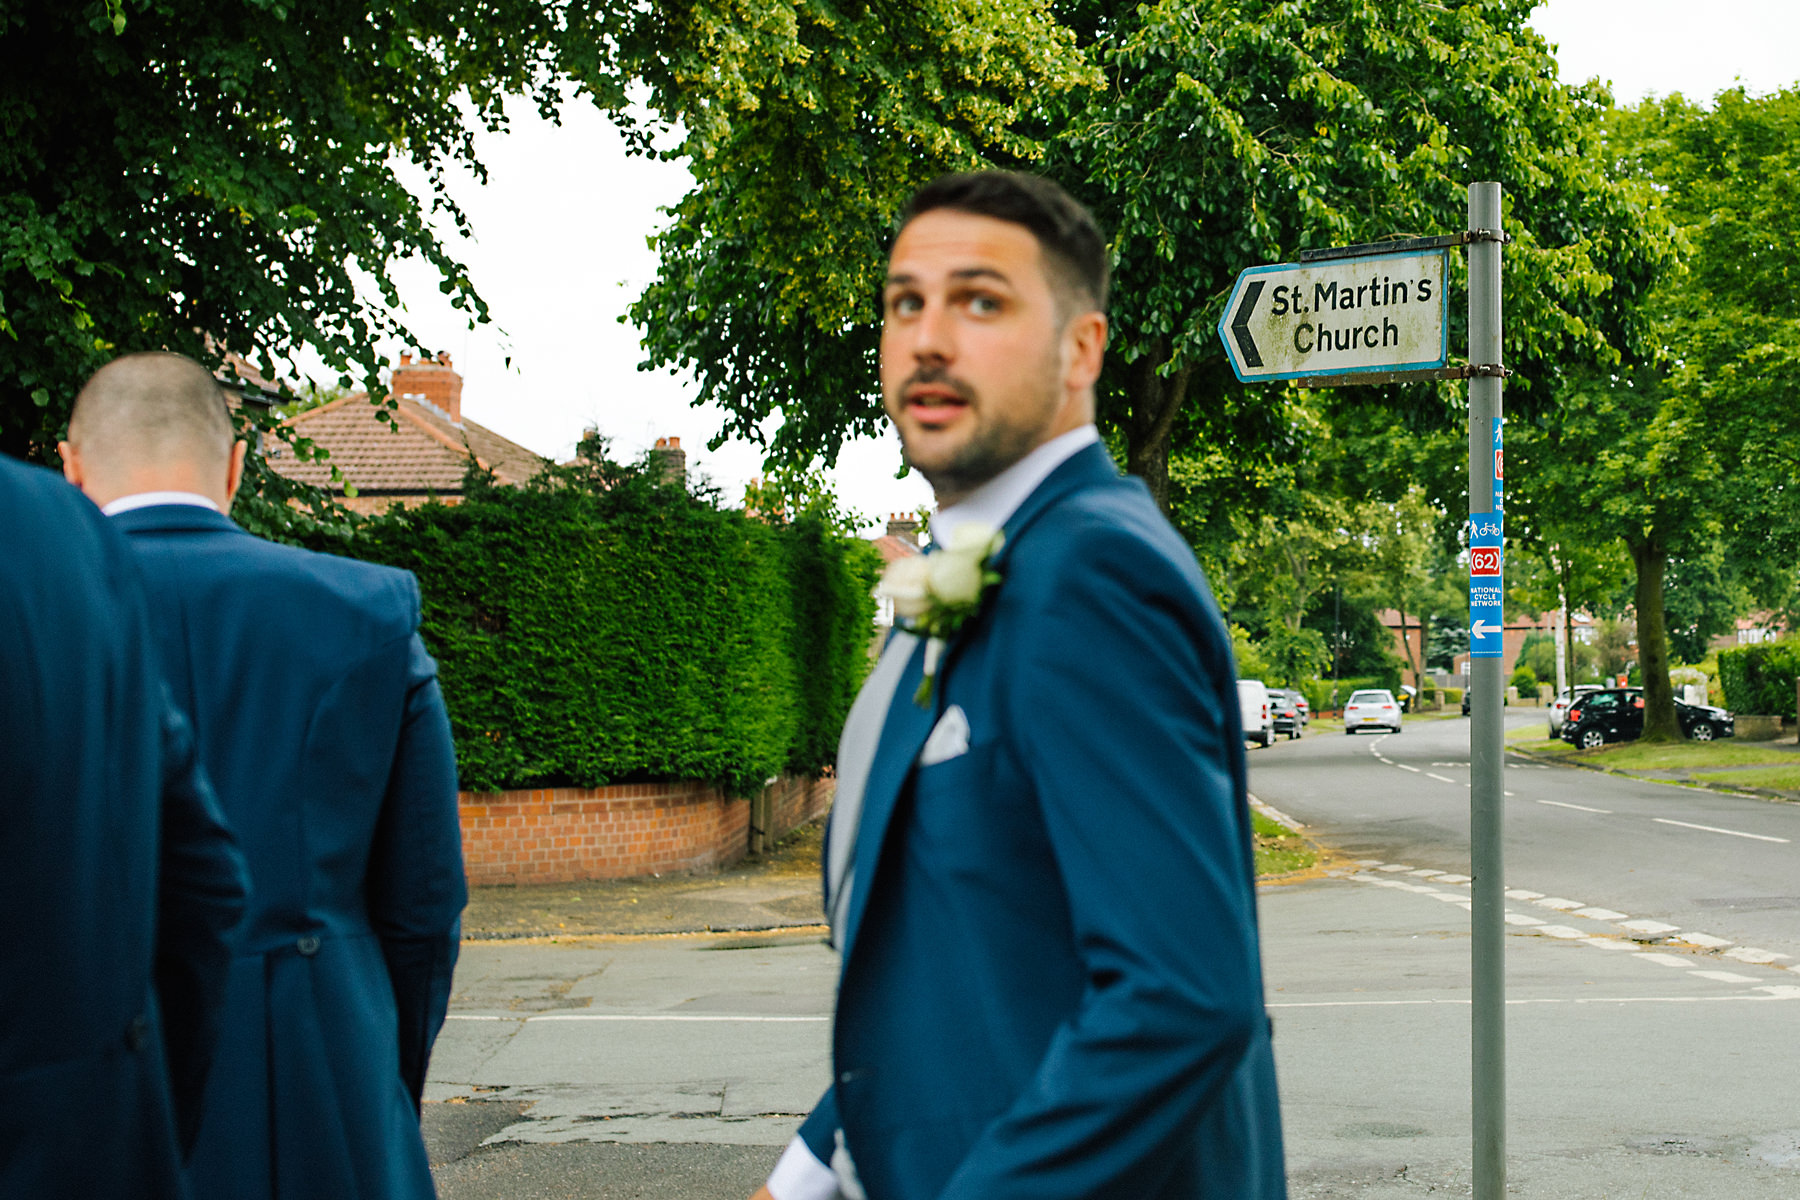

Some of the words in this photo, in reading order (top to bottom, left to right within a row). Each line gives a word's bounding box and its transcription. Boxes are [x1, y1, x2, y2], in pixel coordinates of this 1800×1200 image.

[1271, 285, 1310, 316] St.
[1314, 276, 1432, 312] Martin's
[1294, 317, 1398, 353] Church
